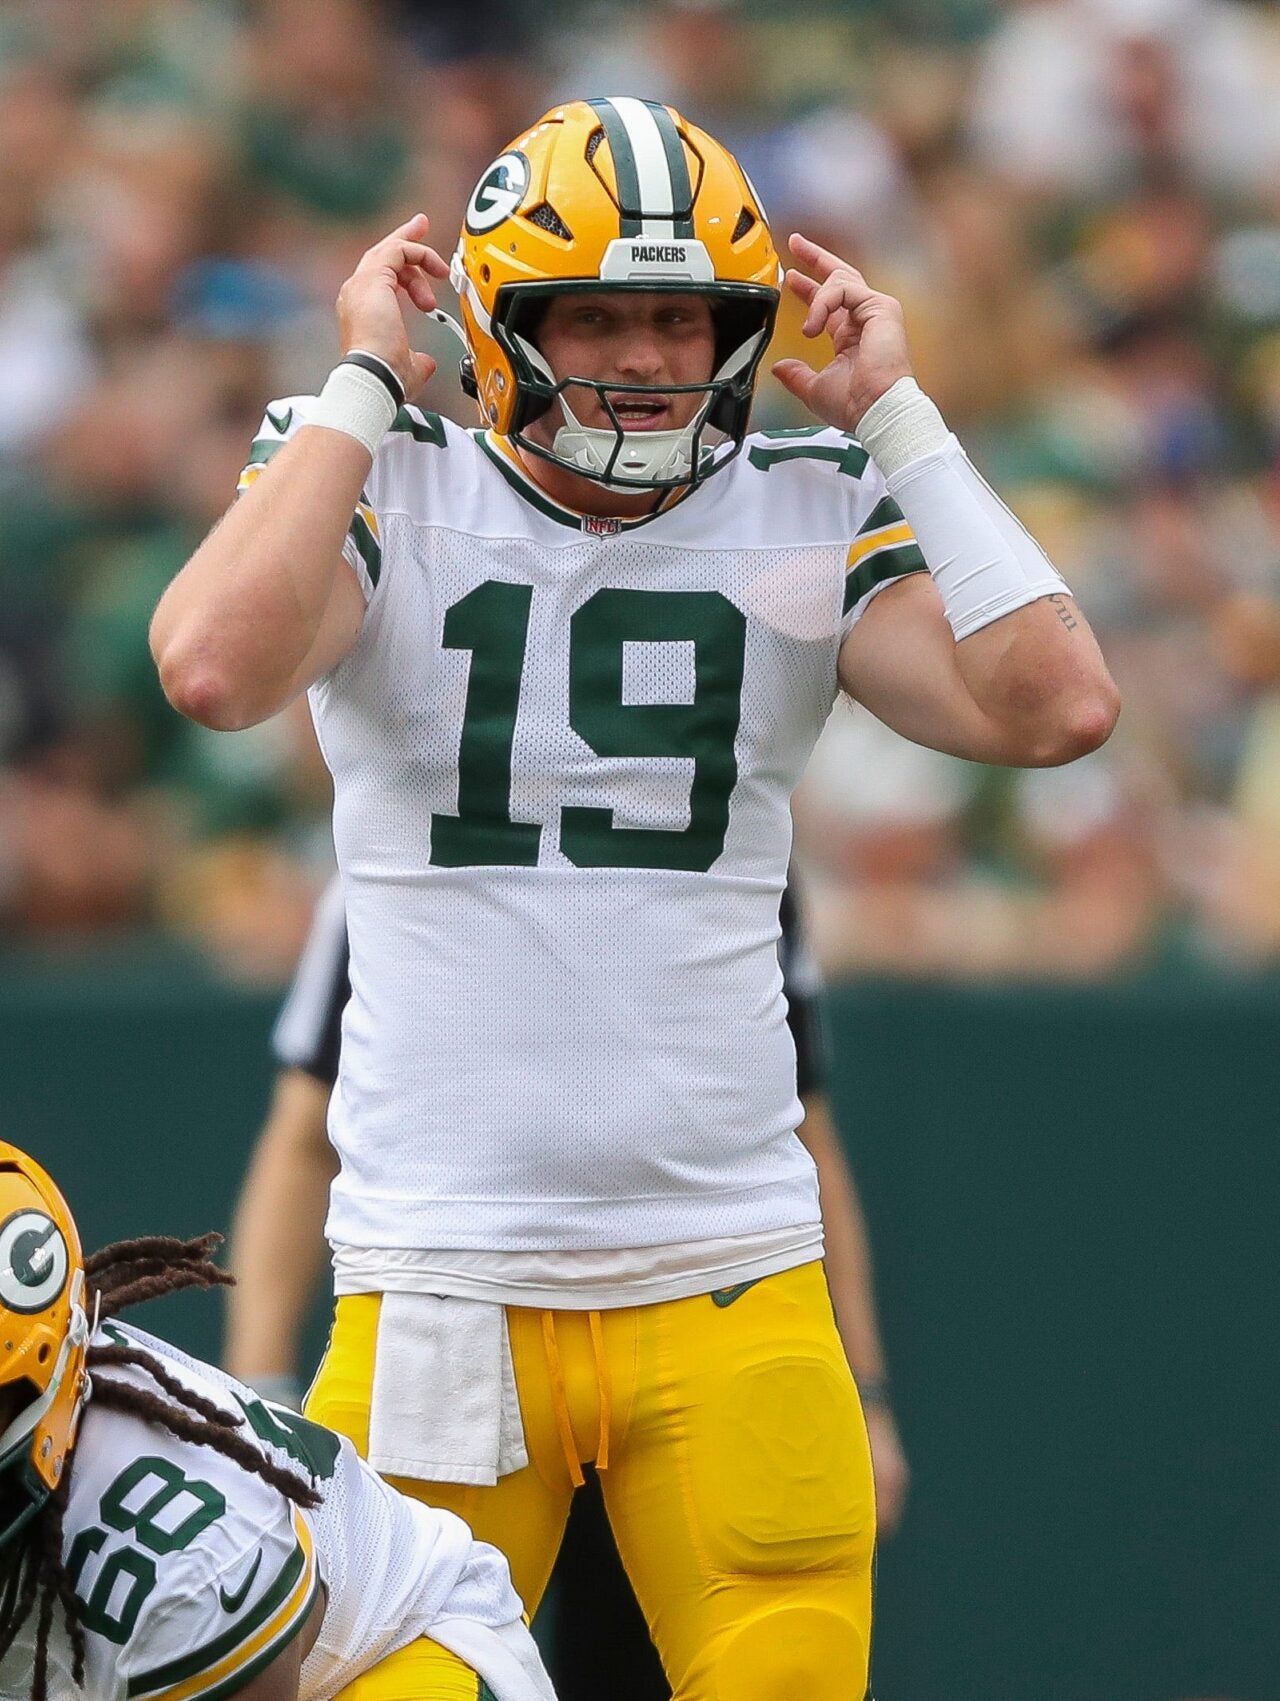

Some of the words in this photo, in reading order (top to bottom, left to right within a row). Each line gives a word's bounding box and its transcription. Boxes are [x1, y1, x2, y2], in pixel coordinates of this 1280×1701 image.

[631, 246, 687, 263] PACKERS
[586, 520, 617, 535] NFL
[429, 580, 747, 872] 19
[66, 1455, 227, 1646] 68
